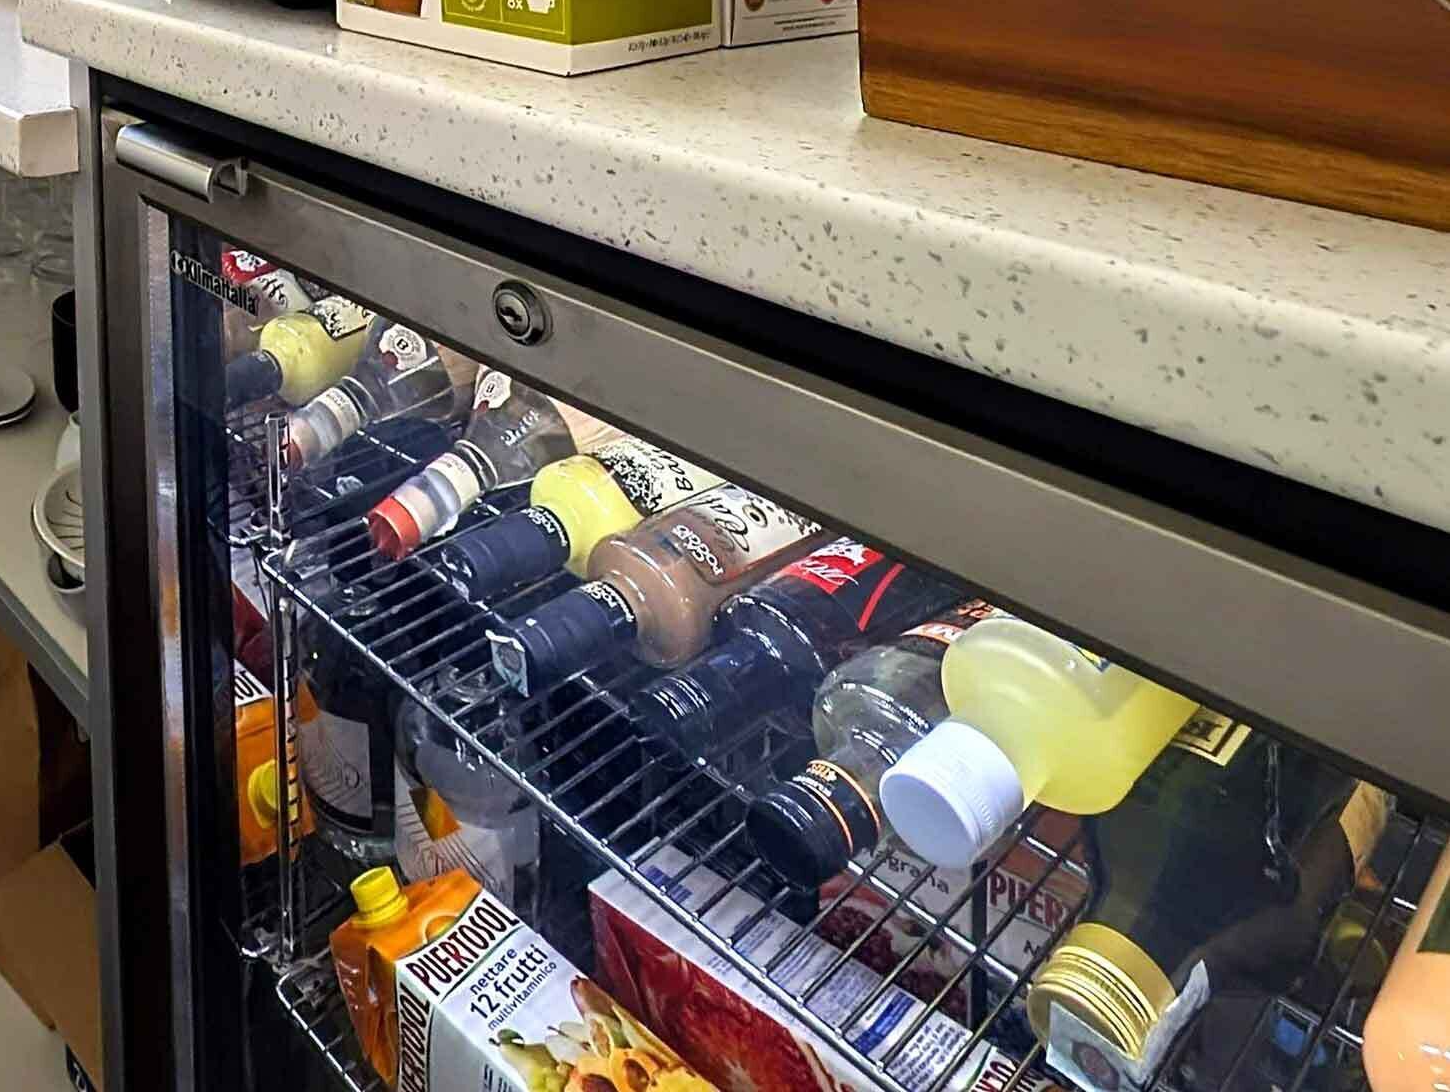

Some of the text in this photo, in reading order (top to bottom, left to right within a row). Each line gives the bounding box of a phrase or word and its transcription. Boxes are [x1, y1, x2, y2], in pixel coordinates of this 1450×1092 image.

[406, 898, 521, 996] PUERTOSOL
[469, 948, 518, 996] nettare
[470, 943, 549, 1019] 12 frutti
[487, 961, 558, 1031] multivitaminico
